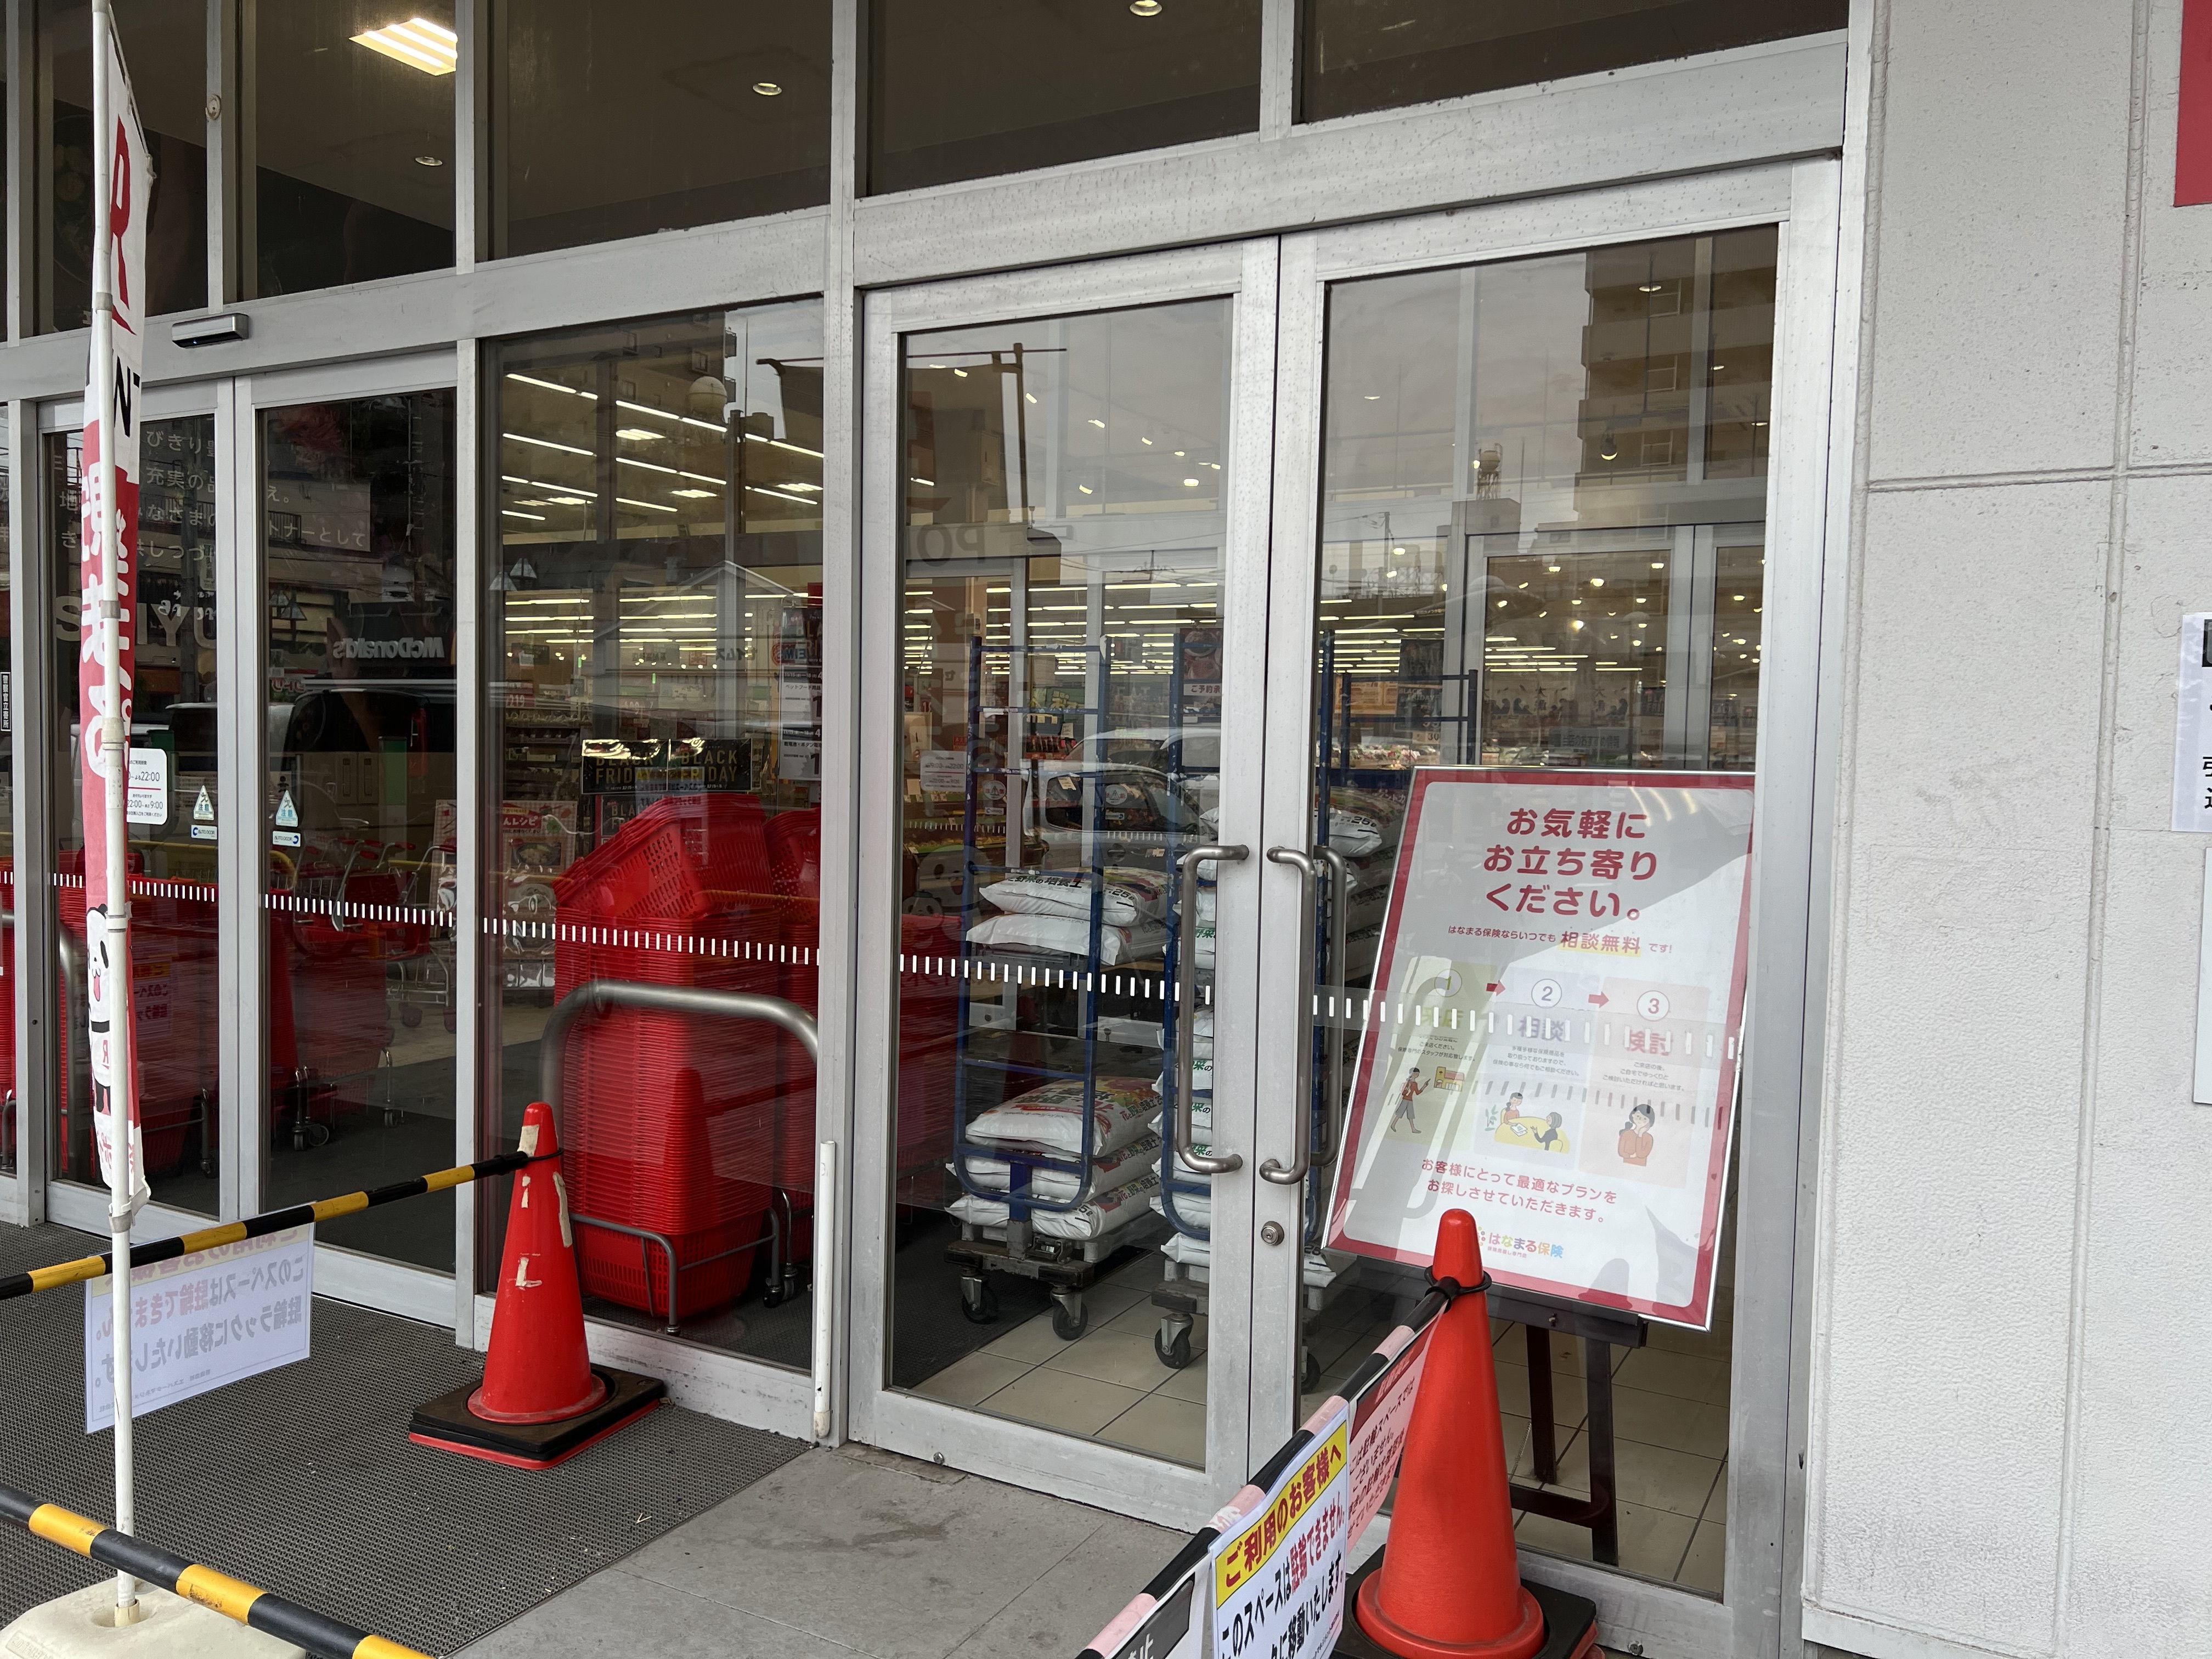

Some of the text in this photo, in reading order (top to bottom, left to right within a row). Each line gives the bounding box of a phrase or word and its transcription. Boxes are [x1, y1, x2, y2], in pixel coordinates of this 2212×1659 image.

[55, 595, 217, 649] SIYU
[681, 749, 738, 765] BLACK
[1506, 808, 1647, 839] お気軽に
[1483, 844, 1657, 881] お立ち寄り
[1486, 883, 1640, 921] ください。
[1448, 926, 1556, 943] はなまる保険ならいつでも
[1560, 930, 1641, 955] 相談無料
[1421, 1158, 1617, 1204] お客様にとって最適なプランを
[1427, 1178, 1604, 1223] お探しさせていただきます。
[1488, 1232, 1564, 1259] はなまる保険
[1226, 1443, 1342, 1588] ご利用のお客様へ
